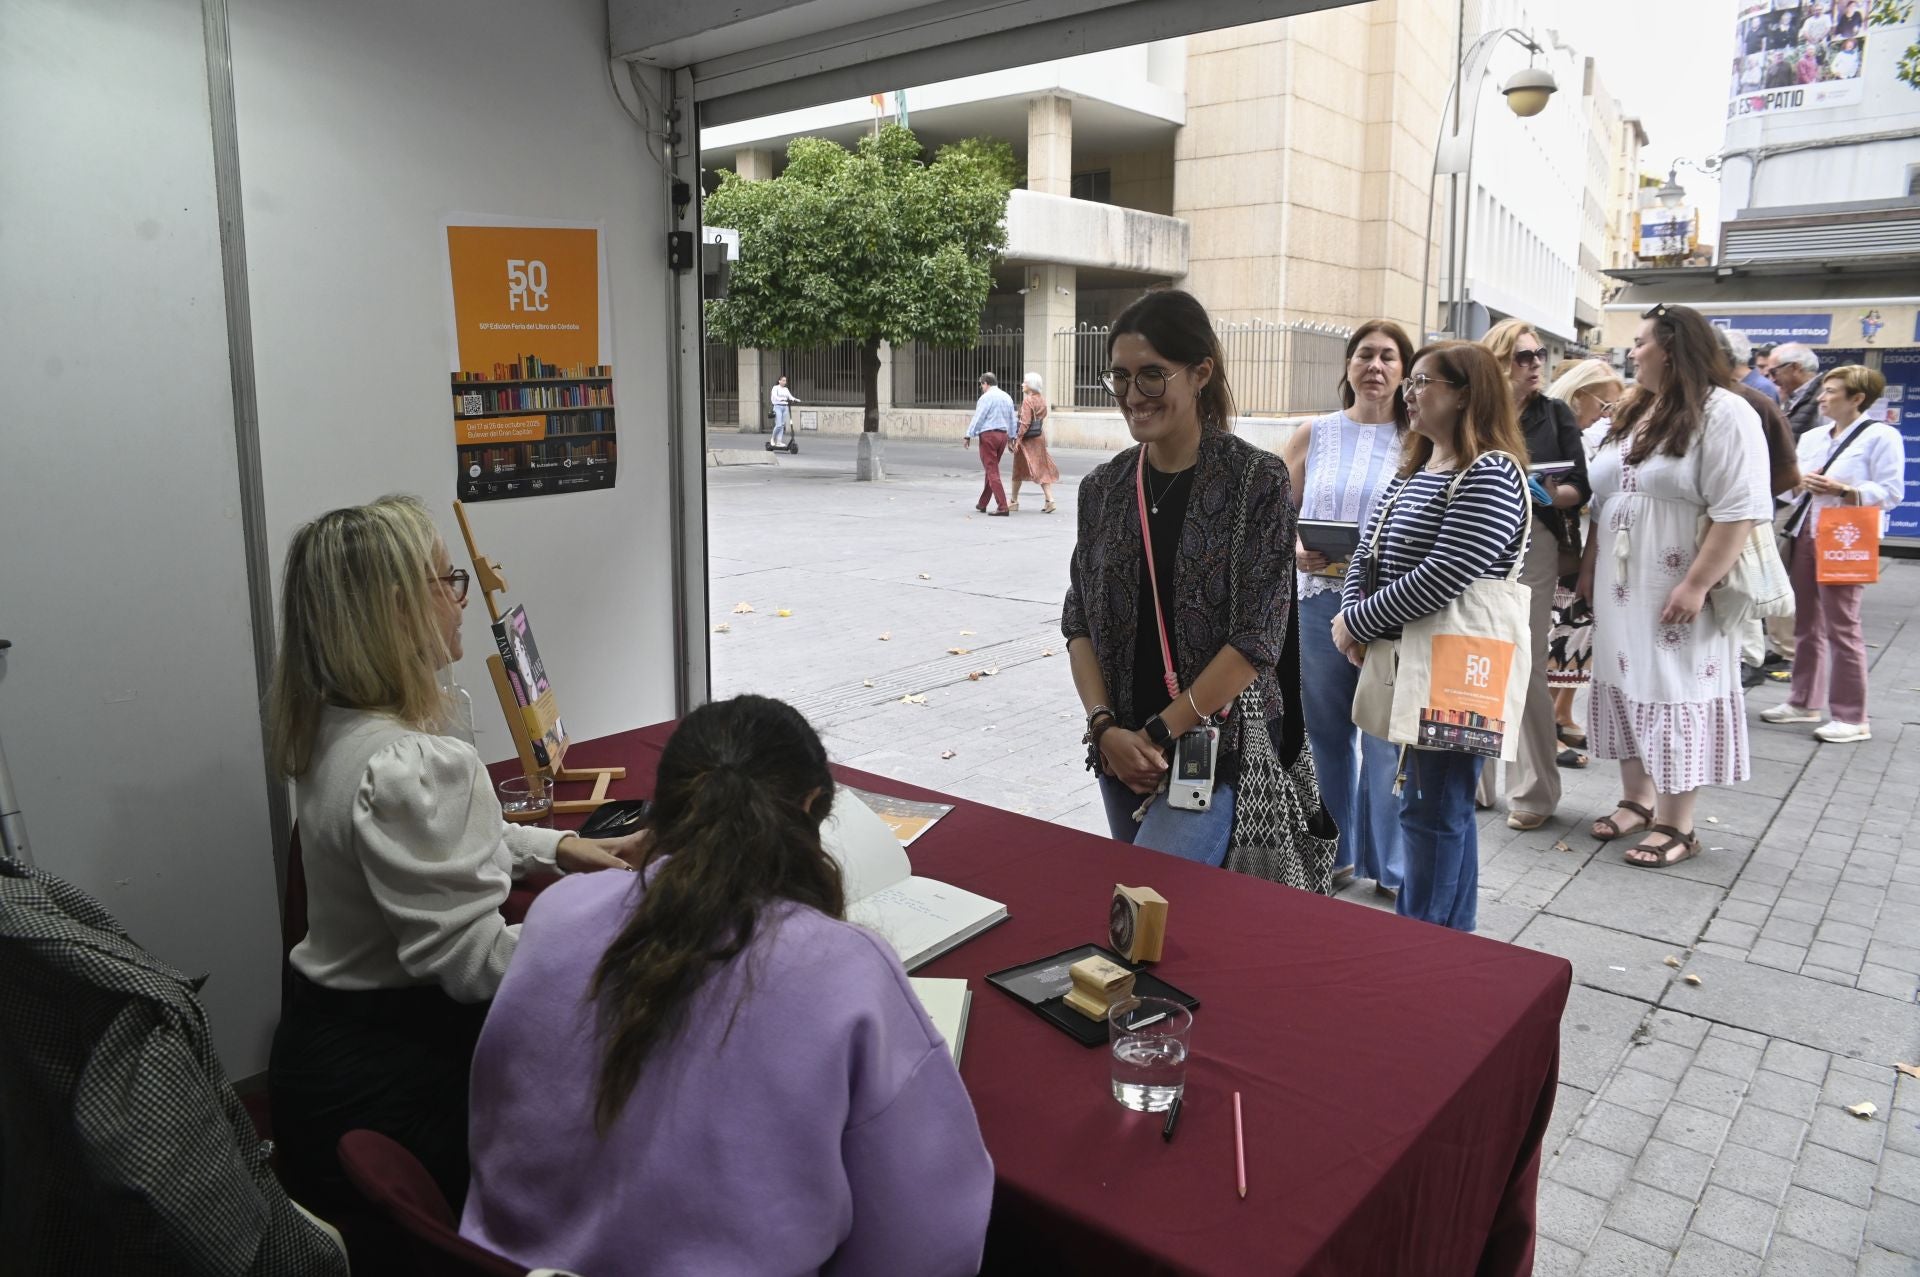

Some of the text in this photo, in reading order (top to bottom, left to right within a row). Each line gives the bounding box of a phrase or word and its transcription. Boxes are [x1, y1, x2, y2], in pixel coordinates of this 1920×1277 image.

[1765, 89, 1804, 110] PATIO
[507, 259, 548, 294] 50
[509, 290, 549, 312] FLC
[1774, 328, 1791, 336] DEL
[1791, 328, 1828, 336] ESTADO
[496, 636, 513, 662] JANE
[1466, 654, 1491, 676] 50
[1464, 672, 1489, 688] FLC
